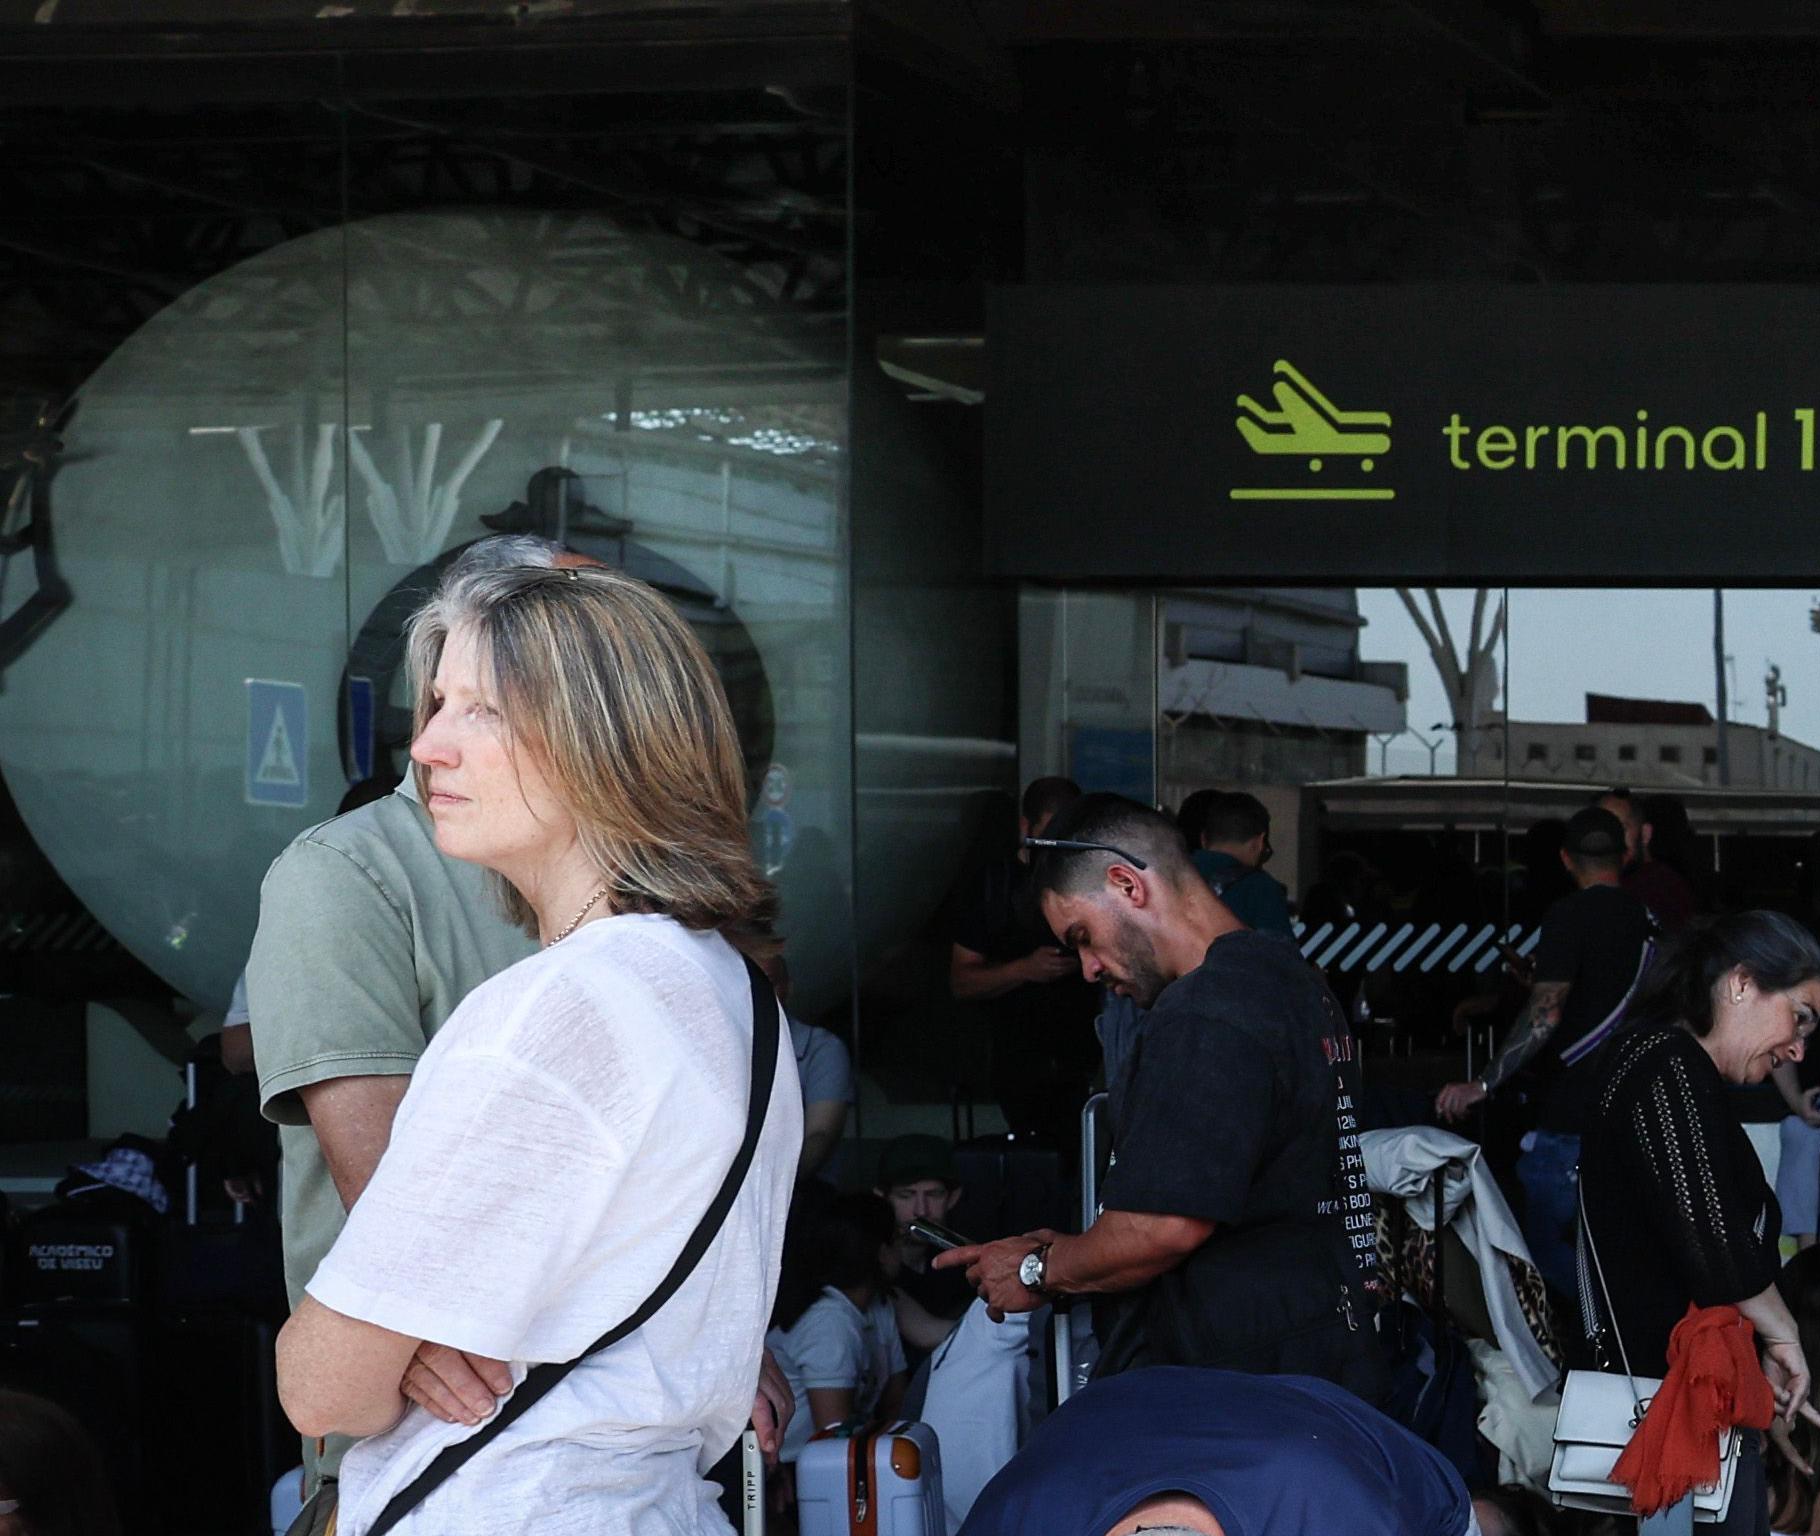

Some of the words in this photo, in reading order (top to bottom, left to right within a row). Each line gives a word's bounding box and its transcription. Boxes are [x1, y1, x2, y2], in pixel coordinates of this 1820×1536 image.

[1444, 410, 1770, 473] terminal
[1793, 408, 1818, 473] 1
[746, 1470, 757, 1511] TRIPP
